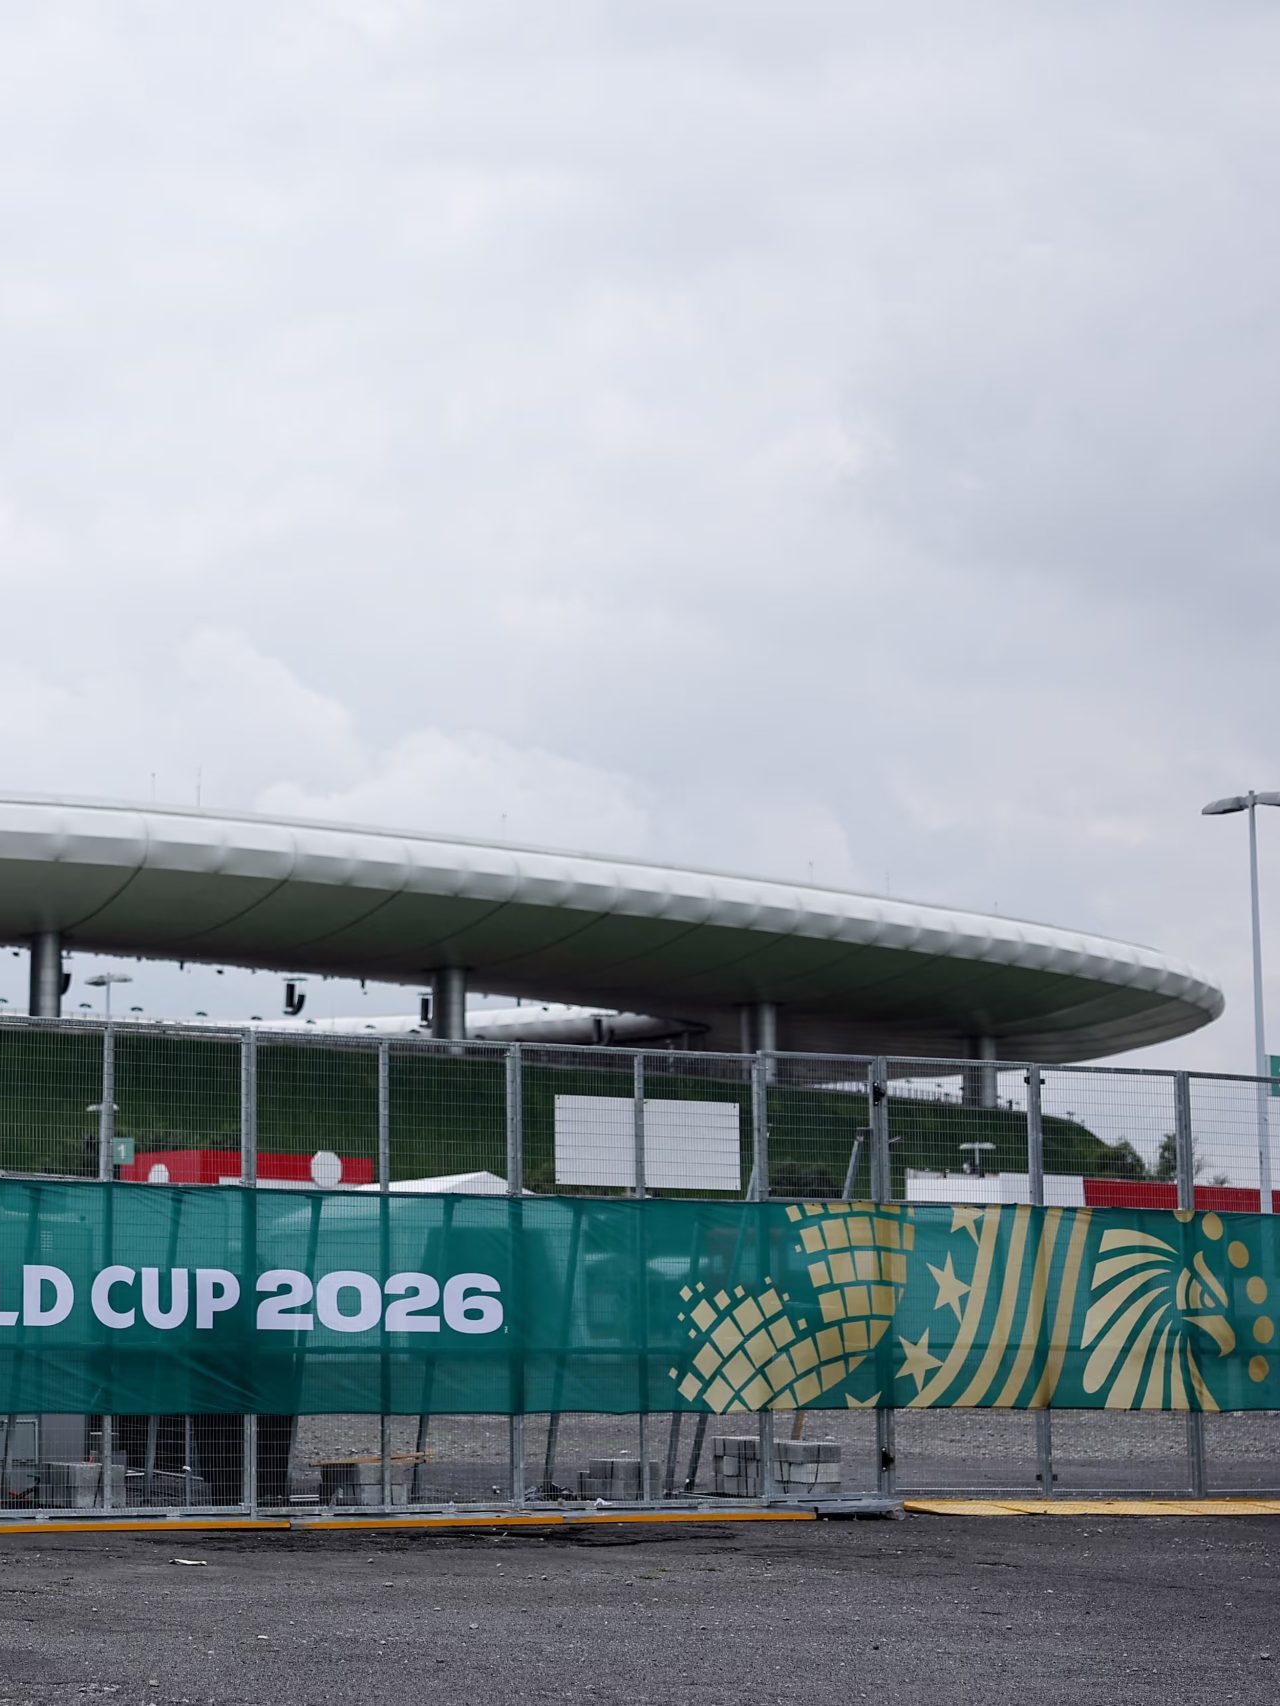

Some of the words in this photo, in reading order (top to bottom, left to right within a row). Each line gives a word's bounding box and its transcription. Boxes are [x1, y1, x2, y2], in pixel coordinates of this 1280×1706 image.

[117, 1144, 125, 1159] 1
[91, 1265, 240, 1330] CUP
[256, 1269, 504, 1335] 2026
